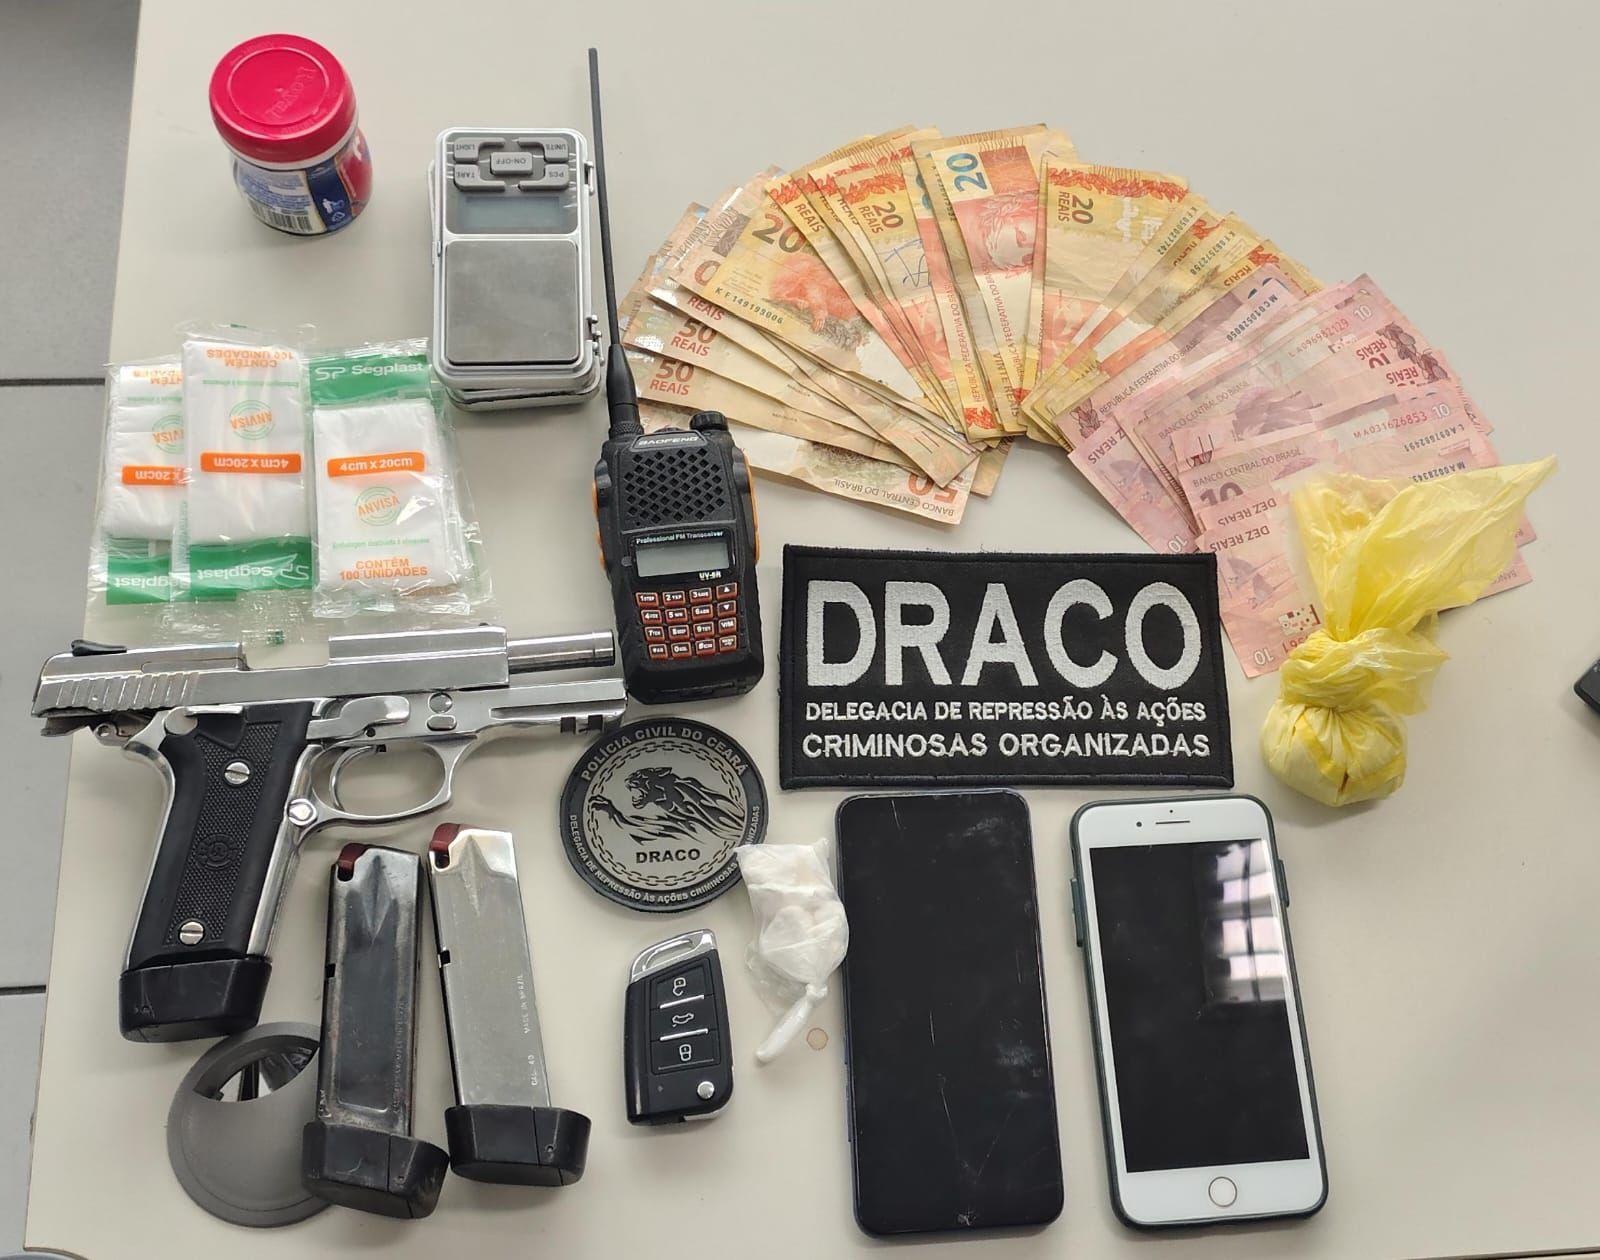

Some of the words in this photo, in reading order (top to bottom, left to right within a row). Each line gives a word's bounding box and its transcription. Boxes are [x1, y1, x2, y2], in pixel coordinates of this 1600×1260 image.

[946, 152, 987, 193] 20
[872, 201, 904, 229] 20
[1058, 191, 1071, 222] REAIS
[1072, 194, 1094, 225] 20
[794, 203, 825, 233] REAIS
[858, 205, 884, 234] REAIS
[752, 213, 807, 254] 20
[687, 296, 725, 321] REAIS
[1354, 304, 1373, 321] 10
[678, 318, 718, 344] 50
[206, 349, 273, 360] UNIDADES
[670, 336, 710, 357] REAIS
[1356, 338, 1388, 360] REAIS
[351, 361, 424, 378] Segplast
[655, 359, 695, 382] 50
[1386, 366, 1419, 384] REAIS
[650, 379, 691, 396] REAIS
[230, 410, 273, 429] ANVISA
[1432, 403, 1450, 418] 10
[1158, 417, 1186, 439] BANCO
[638, 436, 699, 447] BAOFENG
[1087, 436, 1116, 465] REAIS
[214, 458, 249, 470] 20cm
[260, 458, 289, 470] 4cm
[338, 460, 367, 472] 4cm
[378, 457, 414, 470] 20cm
[1192, 472, 1223, 488] BANCO
[1224, 460, 1262, 477] CENTRAL
[1261, 456, 1275, 466] DO
[135, 470, 170, 482] 20cm
[834, 478, 864, 492] BRASIL
[864, 486, 880, 496] DO
[882, 490, 920, 509] CENTRAL
[357, 494, 400, 516] ANVISA
[922, 502, 954, 516] BANCO
[1252, 497, 1278, 515] DEZ
[1218, 509, 1252, 526] REAIS
[636, 534, 674, 544] Professional
[1167, 533, 1188, 552] 10
[1246, 525, 1271, 541] DEZ
[1210, 534, 1244, 552] REAIS
[196, 562, 274, 581] Segplast
[340, 570, 360, 580] 100
[364, 566, 428, 580] UNIDADES
[356, 558, 409, 570] CONTÉM
[806, 578, 1202, 690] DRACO
[1253, 648, 1274, 666] 10
[805, 700, 928, 721] DELEGACIA
[934, 701, 963, 721] DE
[968, 695, 1094, 721] REPRESSÃO
[1100, 694, 1128, 721] ÀS
[1136, 696, 1208, 728] AÇÕES
[581, 736, 632, 782] POLÍCIA
[634, 726, 676, 740] CIVIL
[681, 728, 703, 741] DO
[706, 736, 750, 776] CEARÁ
[802, 732, 987, 758] CRIMINOSAS
[998, 732, 1211, 758] ORGANIZADAS
[570, 814, 588, 863] DELEGACIA
[586, 860, 596, 872] DE
[594, 870, 641, 901] REPRESSÃO
[644, 890, 656, 903] ÀS
[657, 892, 689, 905] AÇÕES
[690, 862, 738, 898] CRIMINOSAS
[636, 848, 700, 864] DRACO
